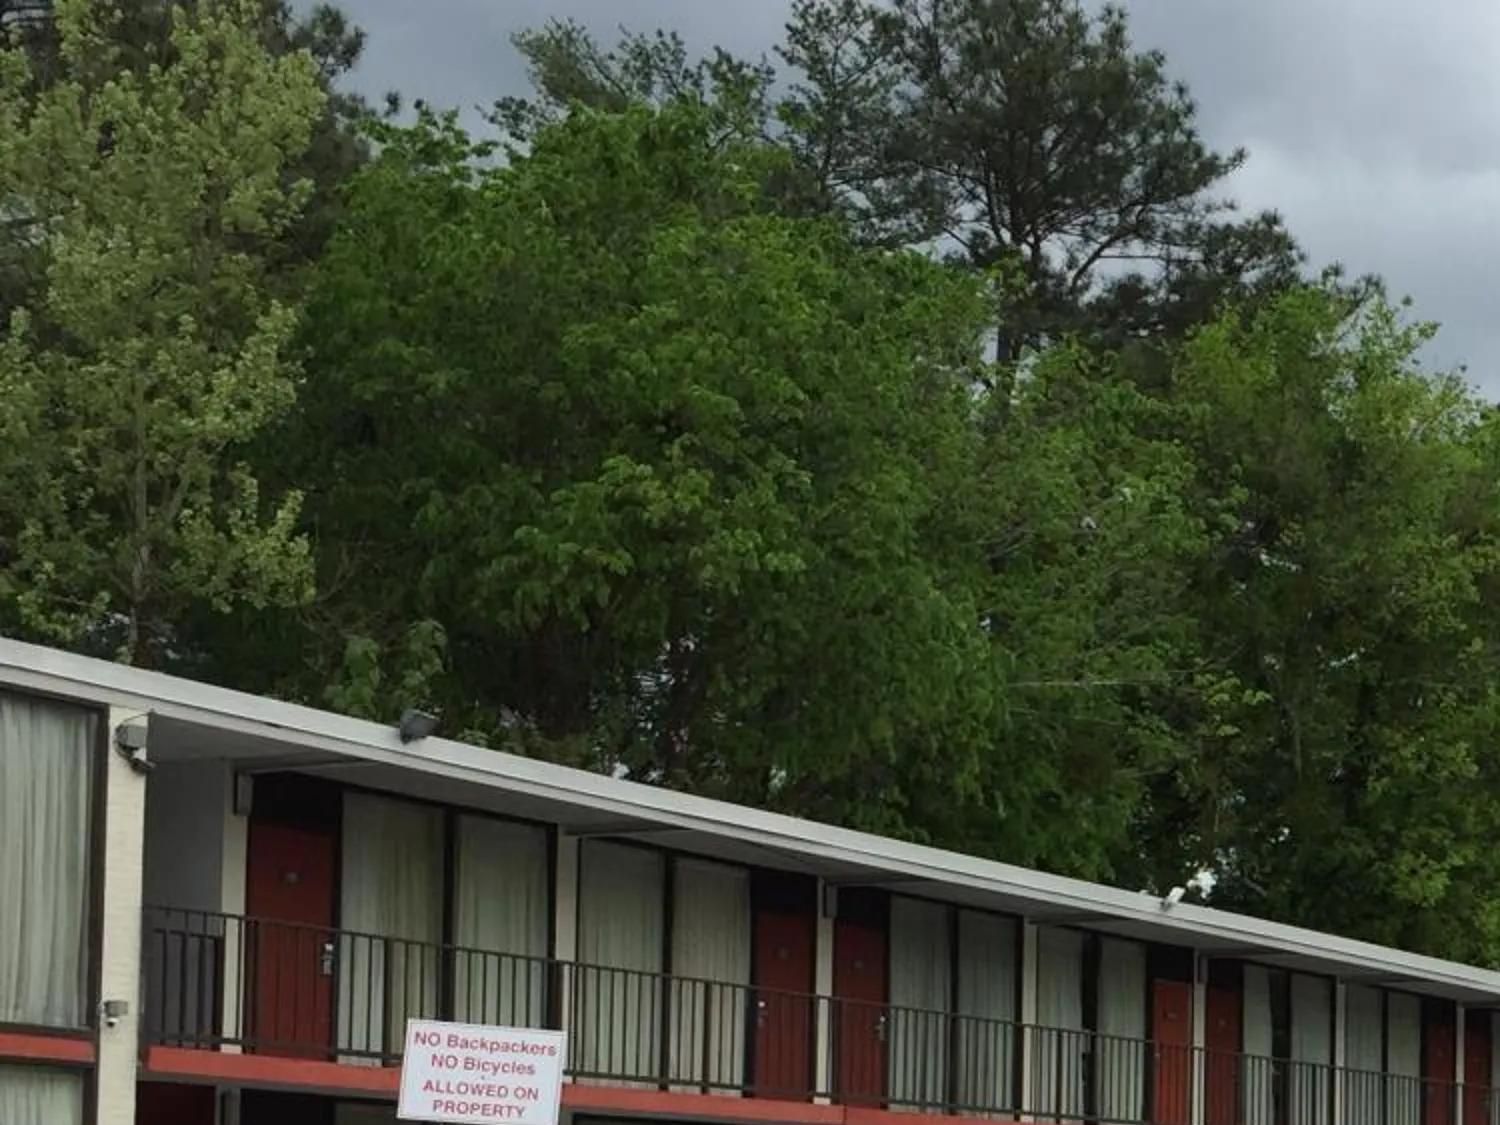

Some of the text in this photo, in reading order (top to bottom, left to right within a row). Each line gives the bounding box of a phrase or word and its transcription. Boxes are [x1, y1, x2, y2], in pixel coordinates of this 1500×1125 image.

[413, 1031, 557, 1057] NO Backpackers
[431, 1054, 536, 1076] NO Bicycles
[422, 1079, 539, 1101] ALLOWED ON
[432, 1099, 526, 1118] PROPERTY
